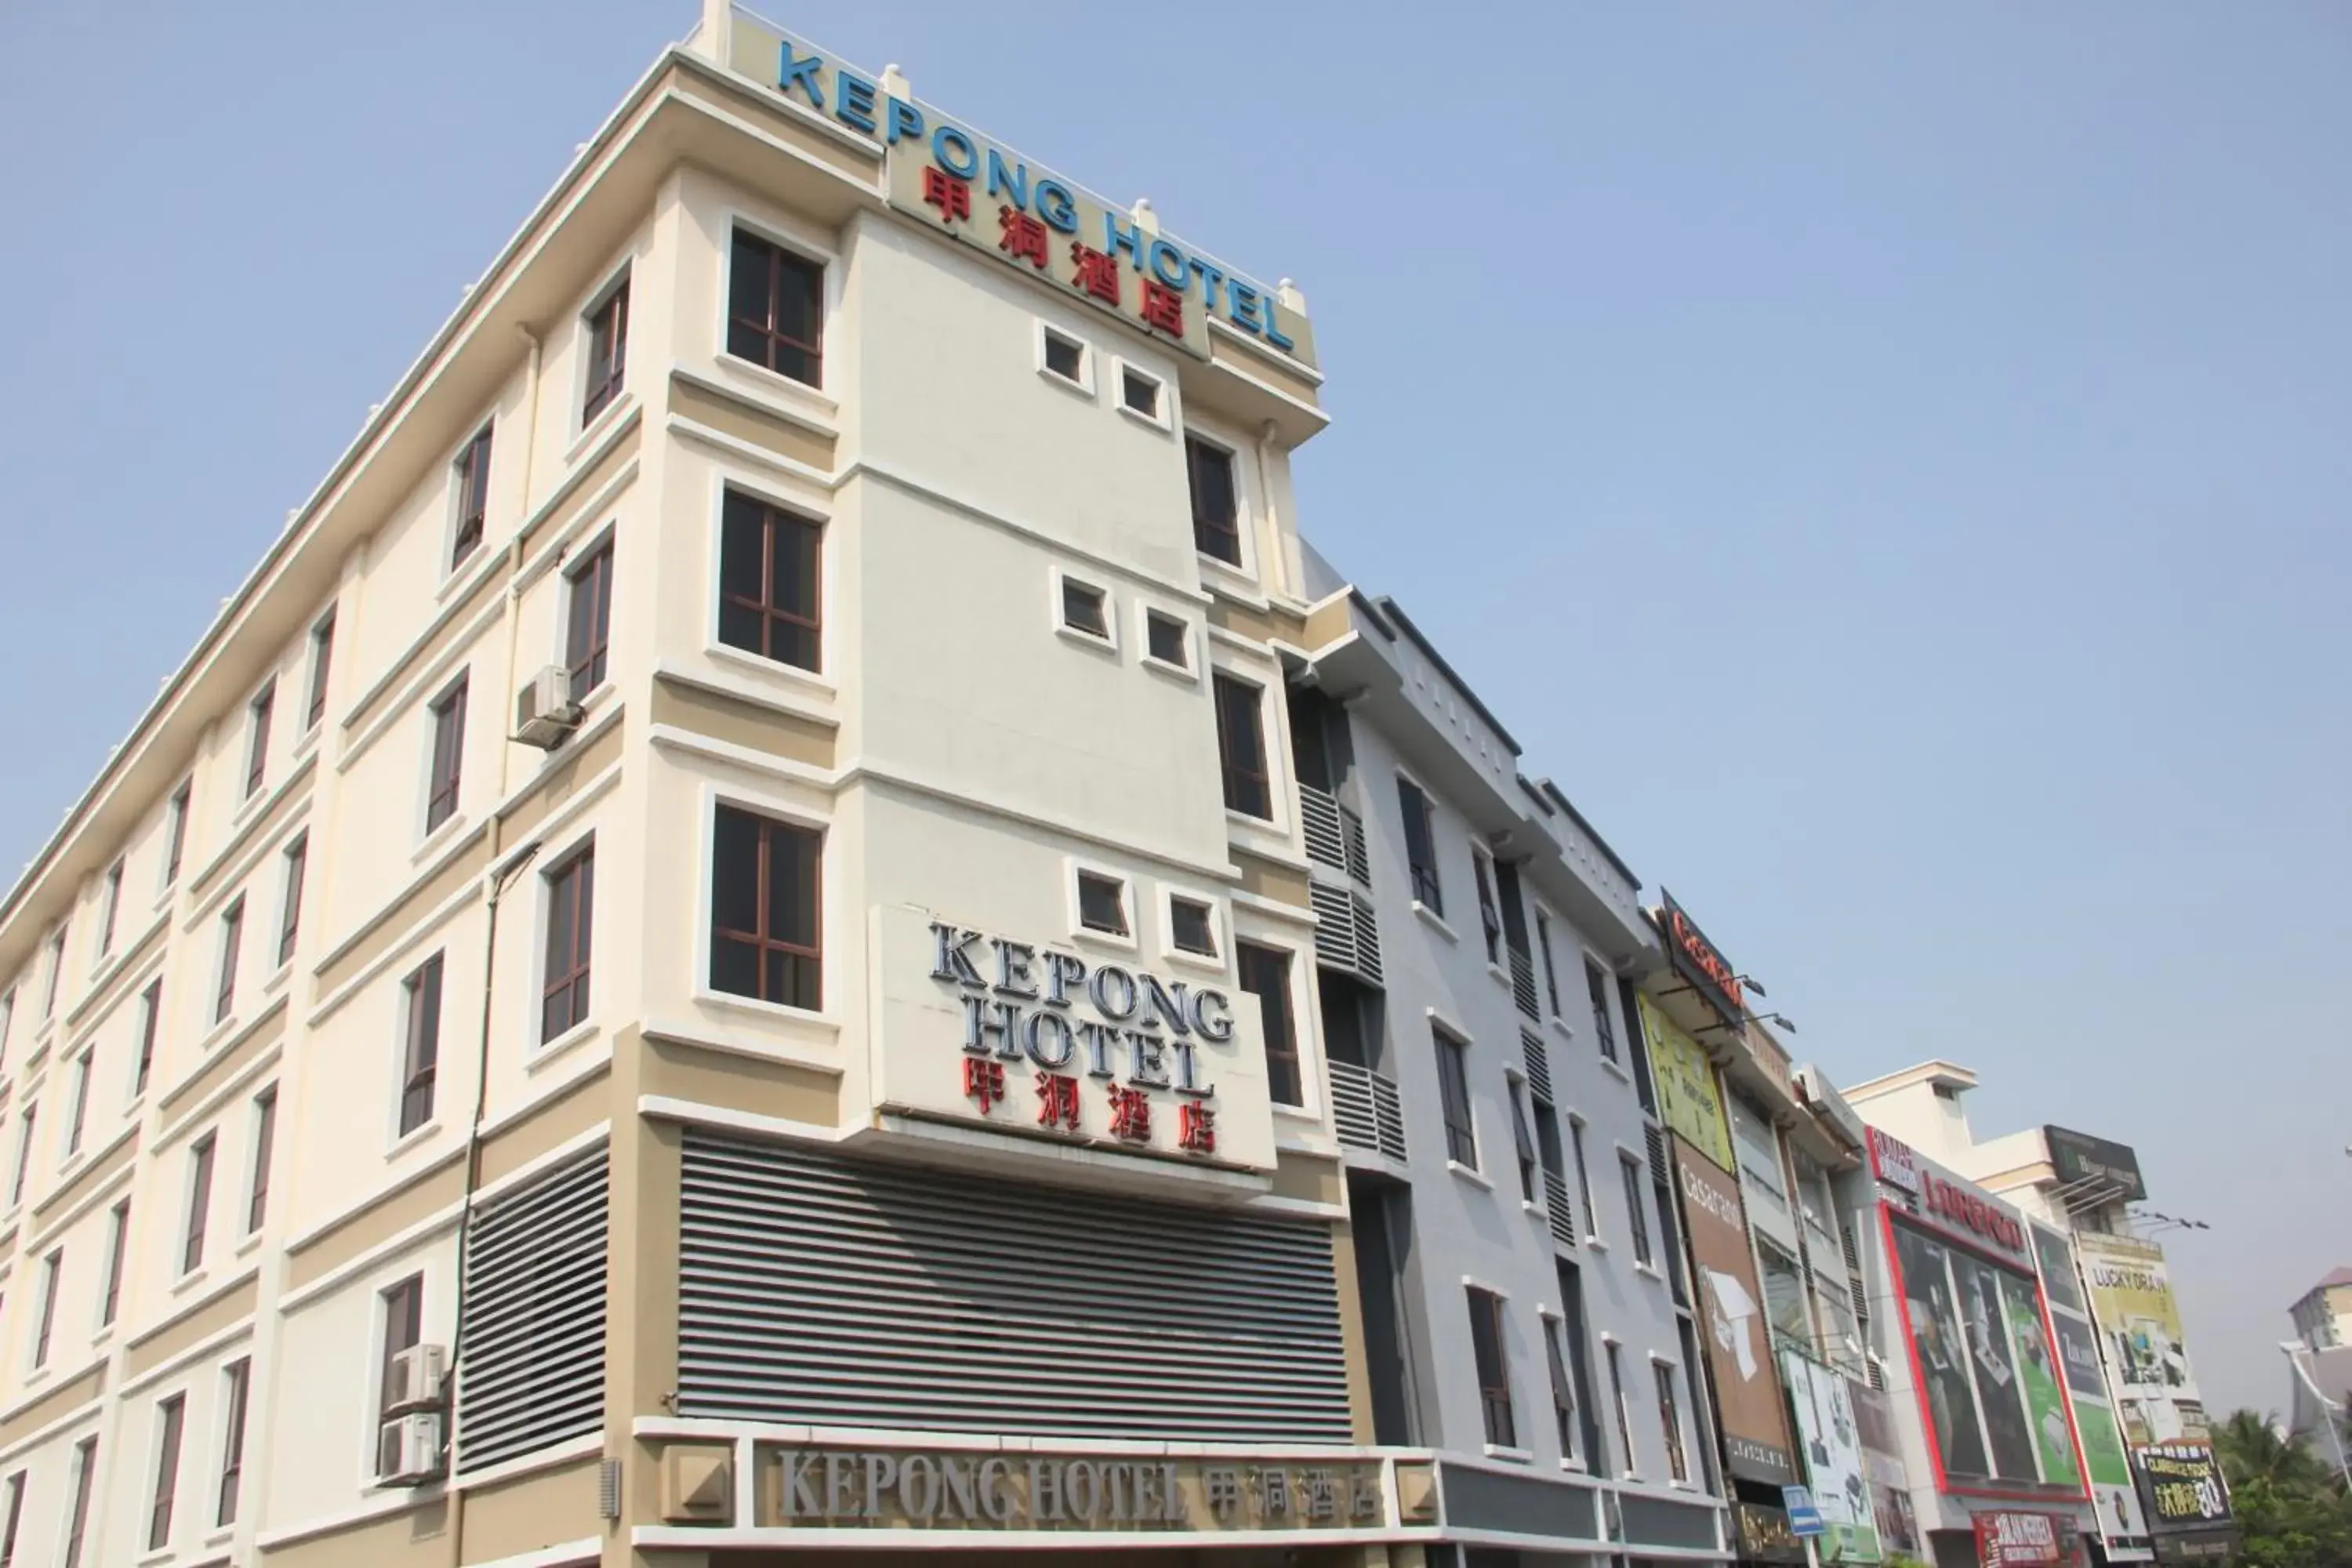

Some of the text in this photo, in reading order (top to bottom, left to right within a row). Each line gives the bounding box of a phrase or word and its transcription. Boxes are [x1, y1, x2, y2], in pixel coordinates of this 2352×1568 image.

[778, 41, 1294, 350] KEPONG HOTEL
[923, 165, 1185, 339] 甲洞酒店
[927, 921, 1235, 1042] KEPONG
[960, 993, 1215, 1098] HOTEL
[963, 1056, 1217, 1154] 甲洞酒店
[778, 1450, 1188, 1522] KEPONG HOTEL
[1203, 1465, 1376, 1519] 甲洞酒店
